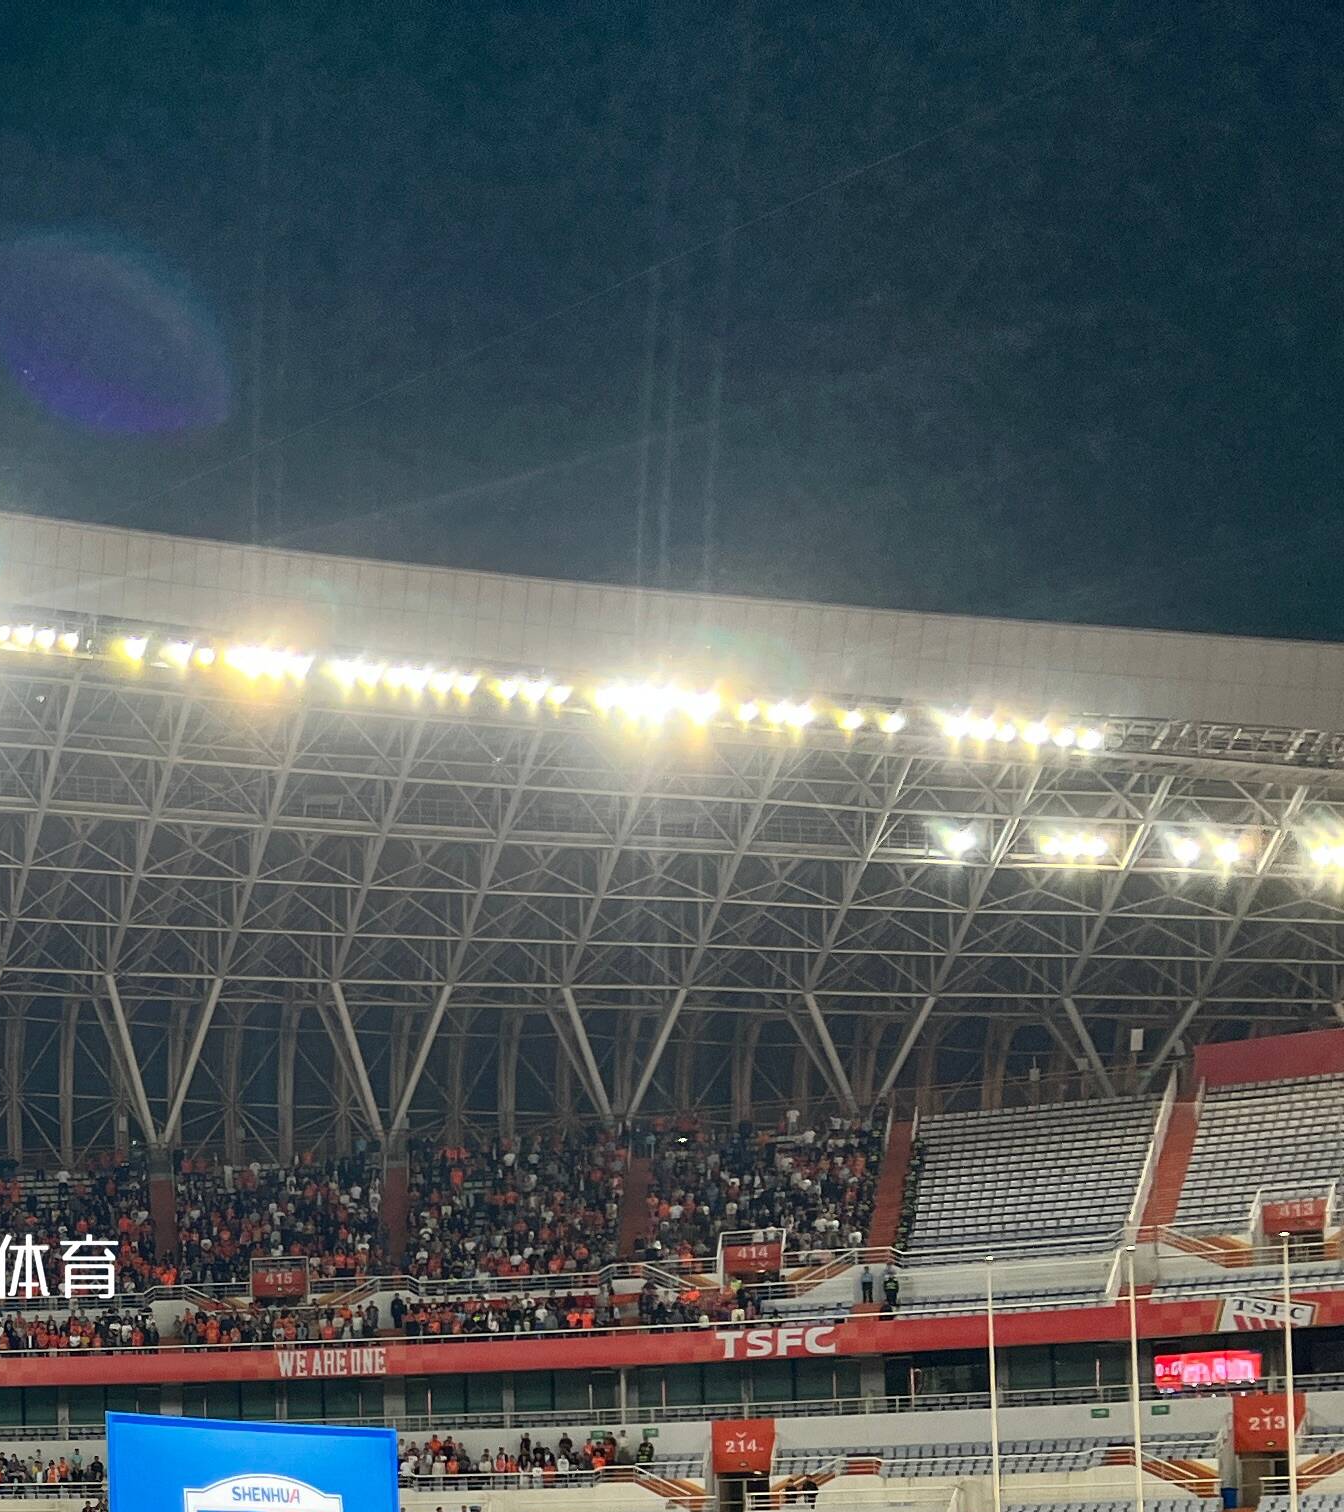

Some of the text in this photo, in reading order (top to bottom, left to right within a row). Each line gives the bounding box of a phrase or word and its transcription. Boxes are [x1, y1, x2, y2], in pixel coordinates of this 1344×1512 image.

[737, 1245, 769, 1259] 414
[1233, 1299, 1305, 1320] TSFC
[715, 1326, 837, 1359] TSFC
[277, 1347, 387, 1378] WE ARE ONE
[1248, 1416, 1286, 1431] 213
[725, 1440, 757, 1453] 214
[231, 1486, 301, 1504] SHENHUA
